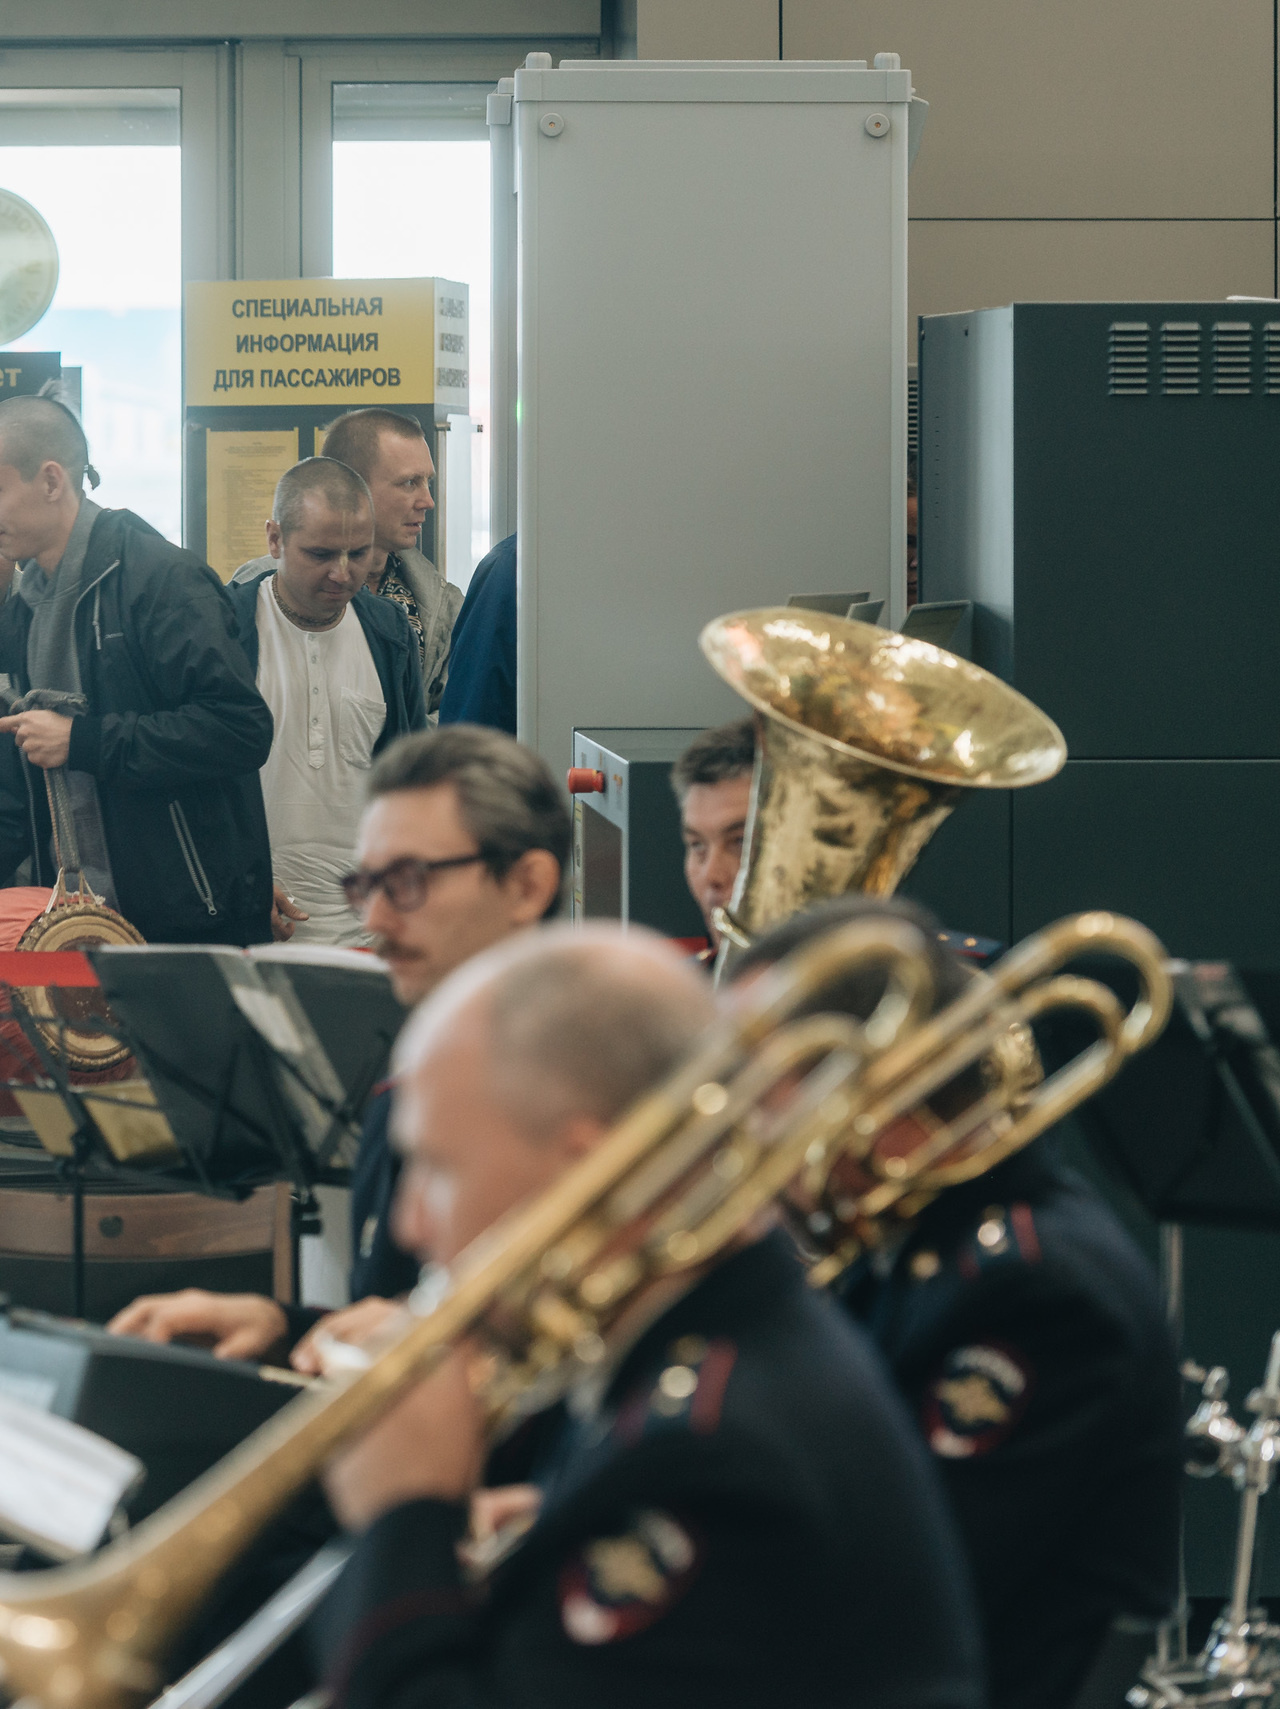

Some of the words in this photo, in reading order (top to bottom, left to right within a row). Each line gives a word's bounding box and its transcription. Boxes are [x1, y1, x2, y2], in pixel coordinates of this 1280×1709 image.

[231, 296, 383, 321] СПЕЦИАЛЬНАЯ
[236, 332, 379, 356] ИНФОРМАЦИЯ
[213, 369, 254, 392] ДЛЯ
[260, 367, 402, 389] ПАССАЖИРОВ
